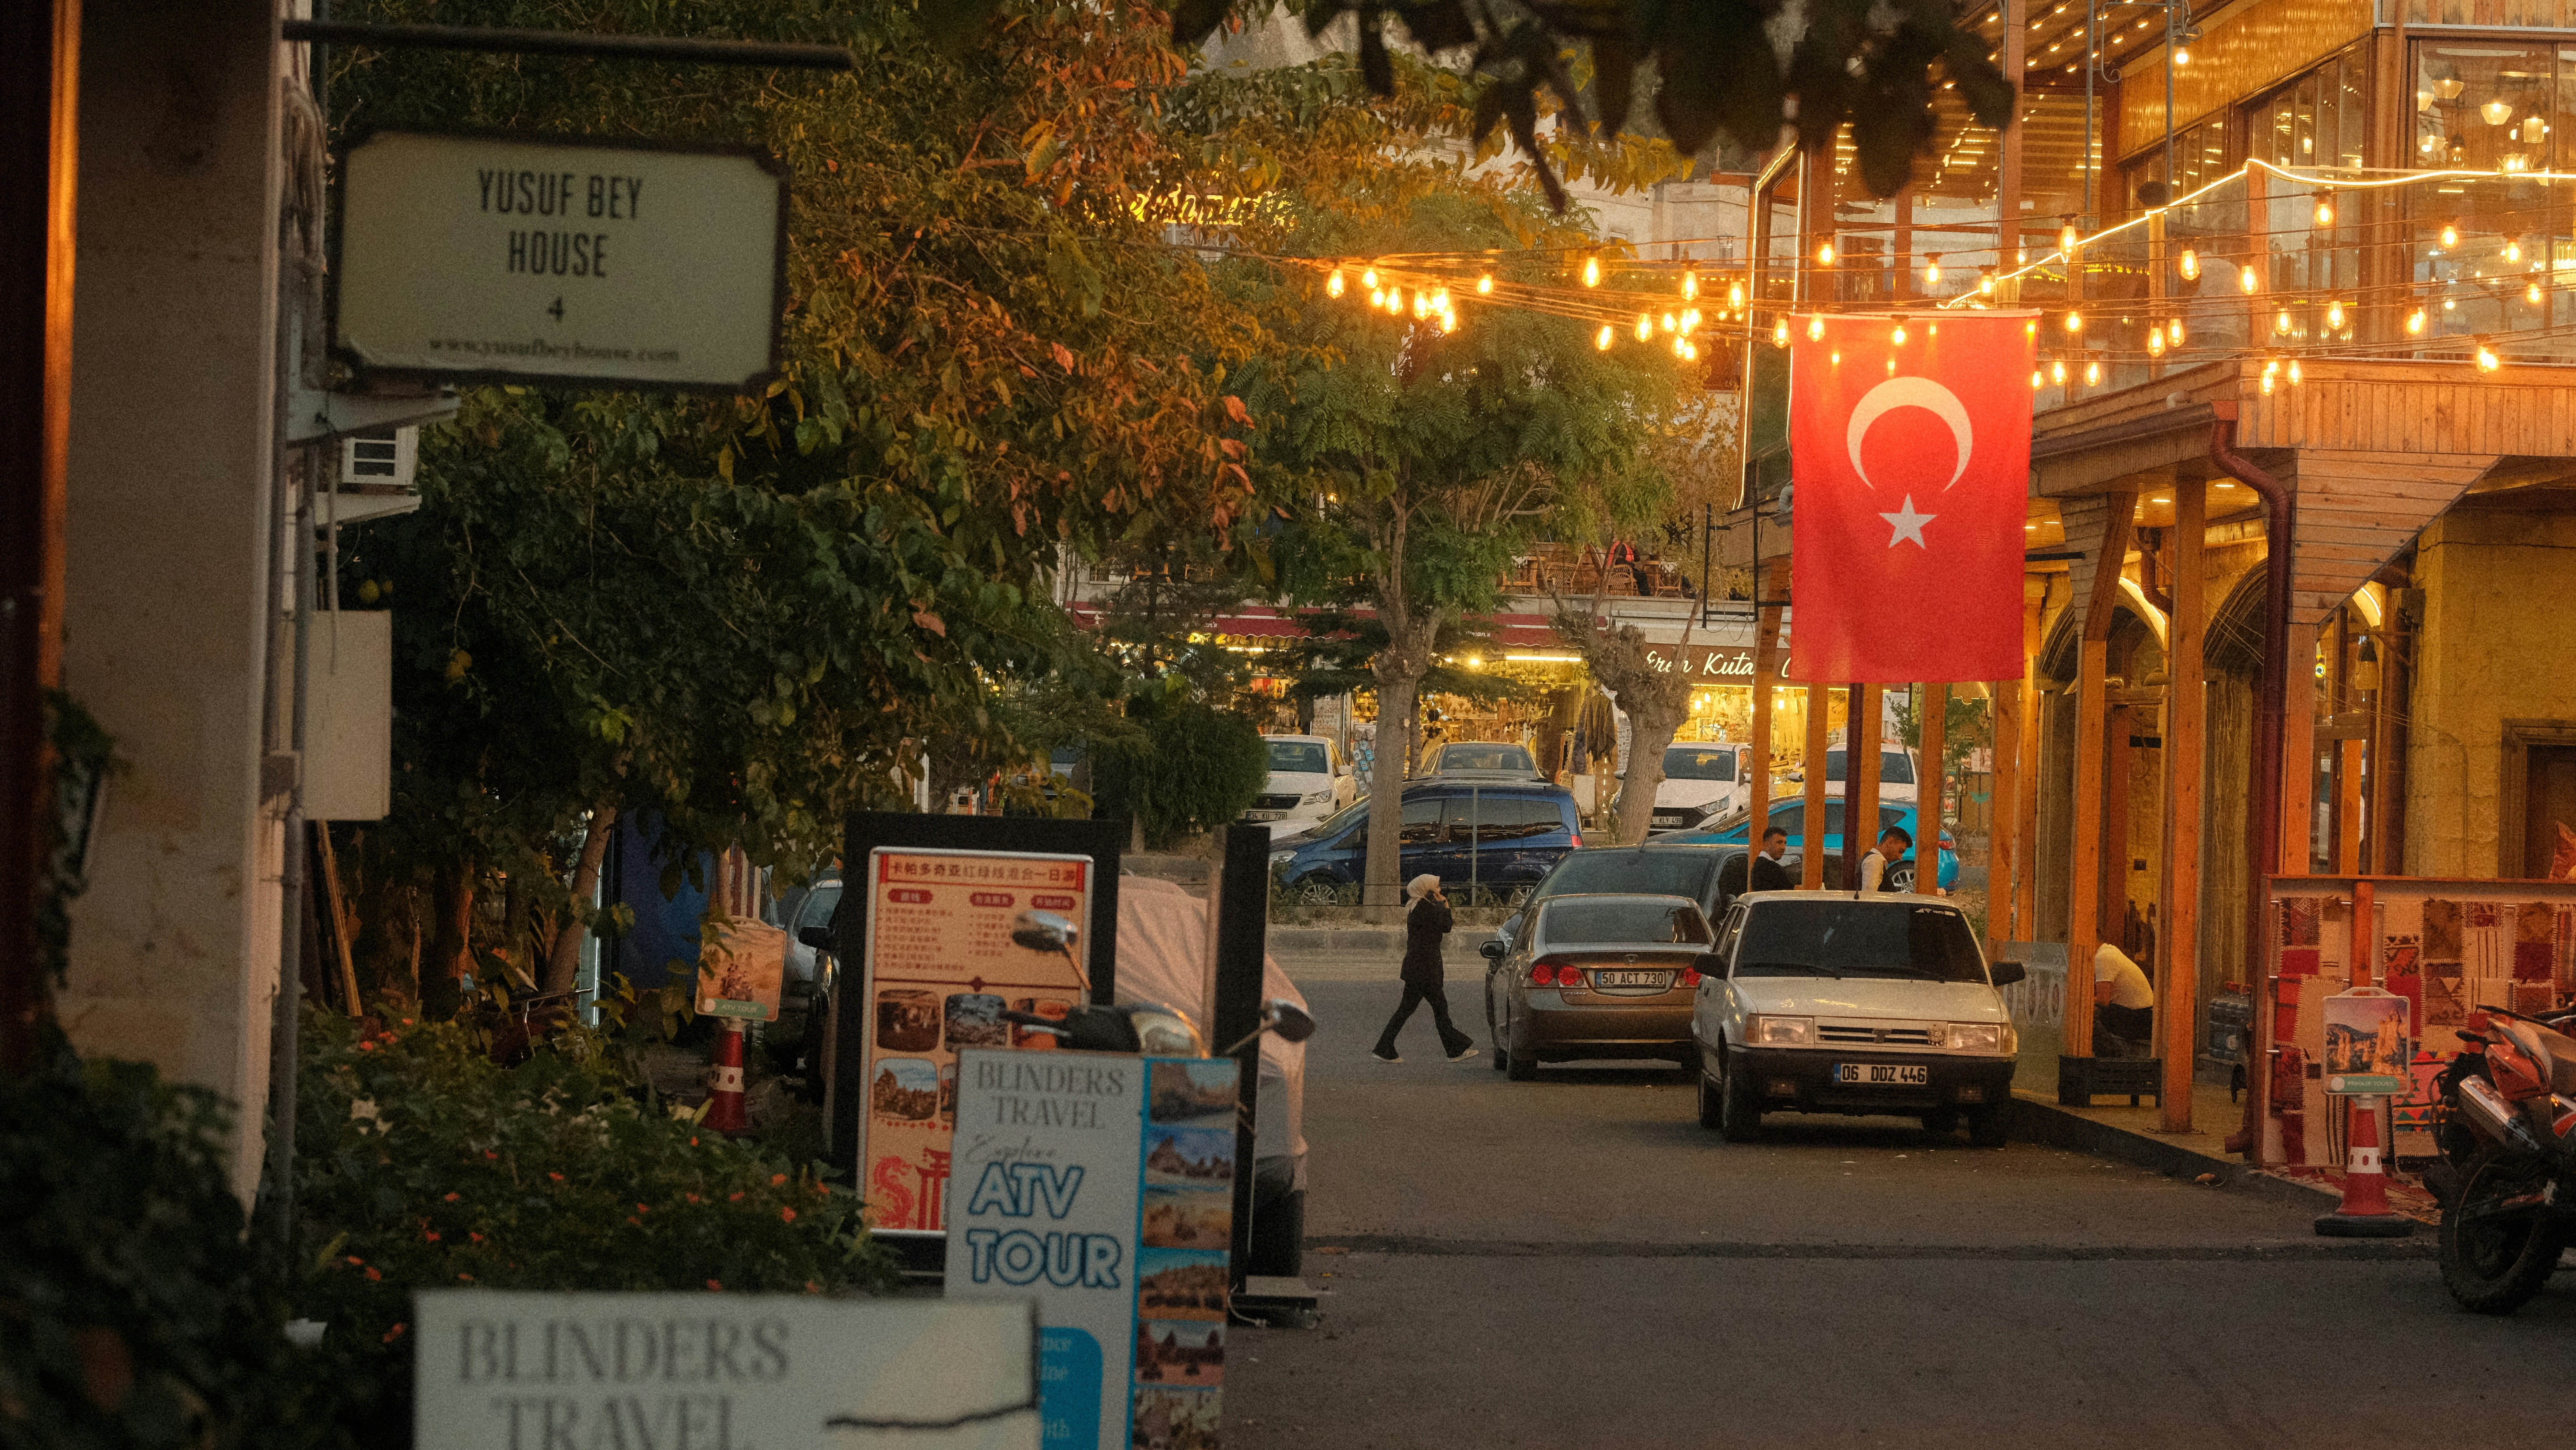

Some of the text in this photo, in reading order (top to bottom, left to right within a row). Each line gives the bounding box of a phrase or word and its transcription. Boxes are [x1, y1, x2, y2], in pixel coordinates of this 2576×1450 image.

[478, 170, 643, 220] YUSUF BEY
[508, 230, 608, 277] HOUSE
[547, 297, 564, 322] 4
[1602, 973, 1663, 984] 50 ACT 730
[977, 1060, 1124, 1095] BLINDERS
[1842, 1065, 1925, 1083] 06 DDZ 446
[992, 1095, 1106, 1130] TRAVEL
[968, 1162, 1084, 1219] ATV
[966, 1228, 1121, 1289] TOUR
[457, 1318, 790, 1383] BLINDERS
